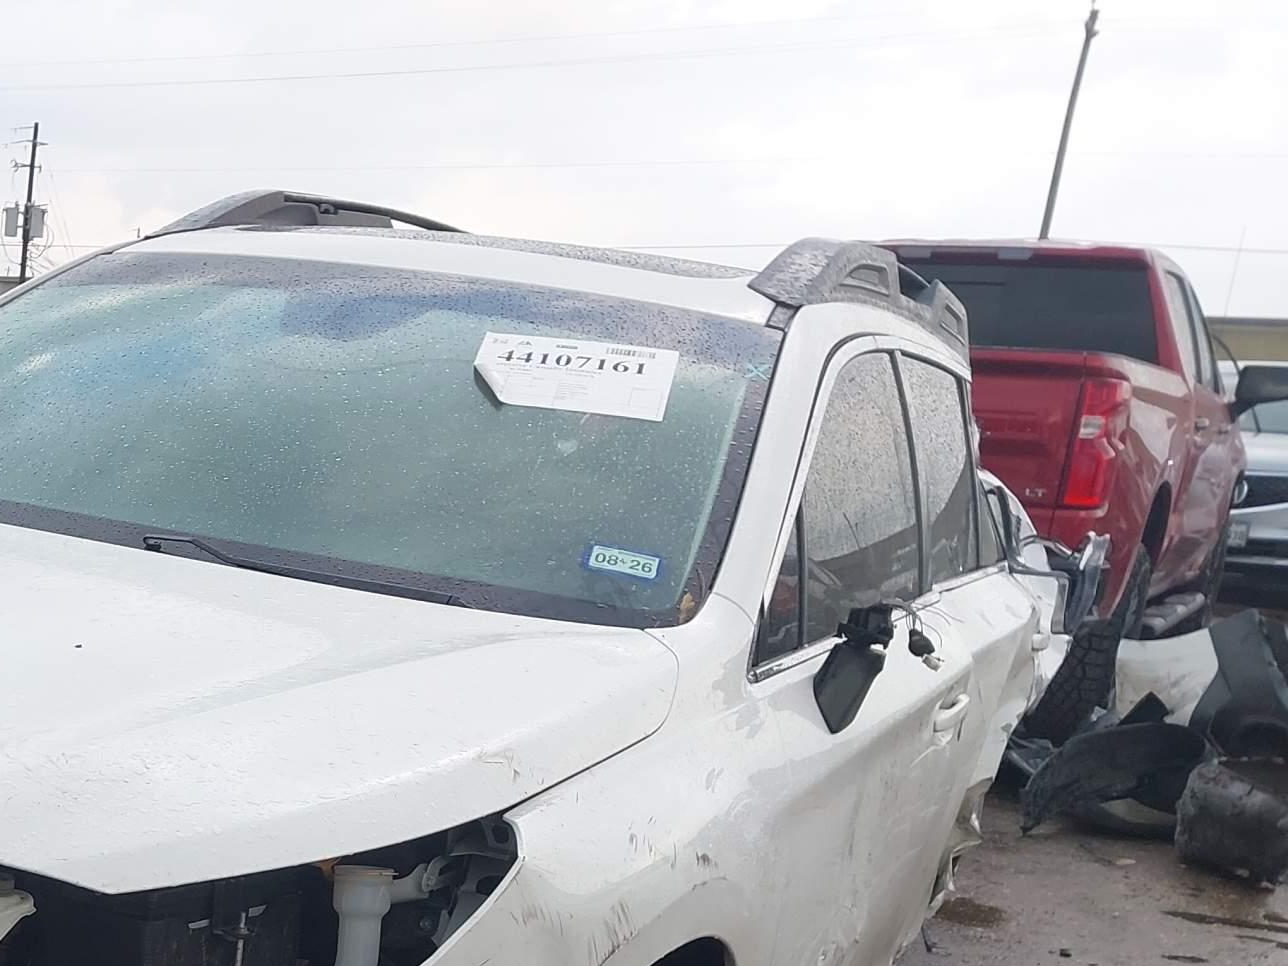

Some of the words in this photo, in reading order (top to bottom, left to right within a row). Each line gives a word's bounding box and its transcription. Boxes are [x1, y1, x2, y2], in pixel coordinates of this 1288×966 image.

[497, 349, 649, 375] 44107161
[1024, 488, 1046, 497] LT
[594, 552, 619, 566] 08
[628, 559, 653, 573] 26
